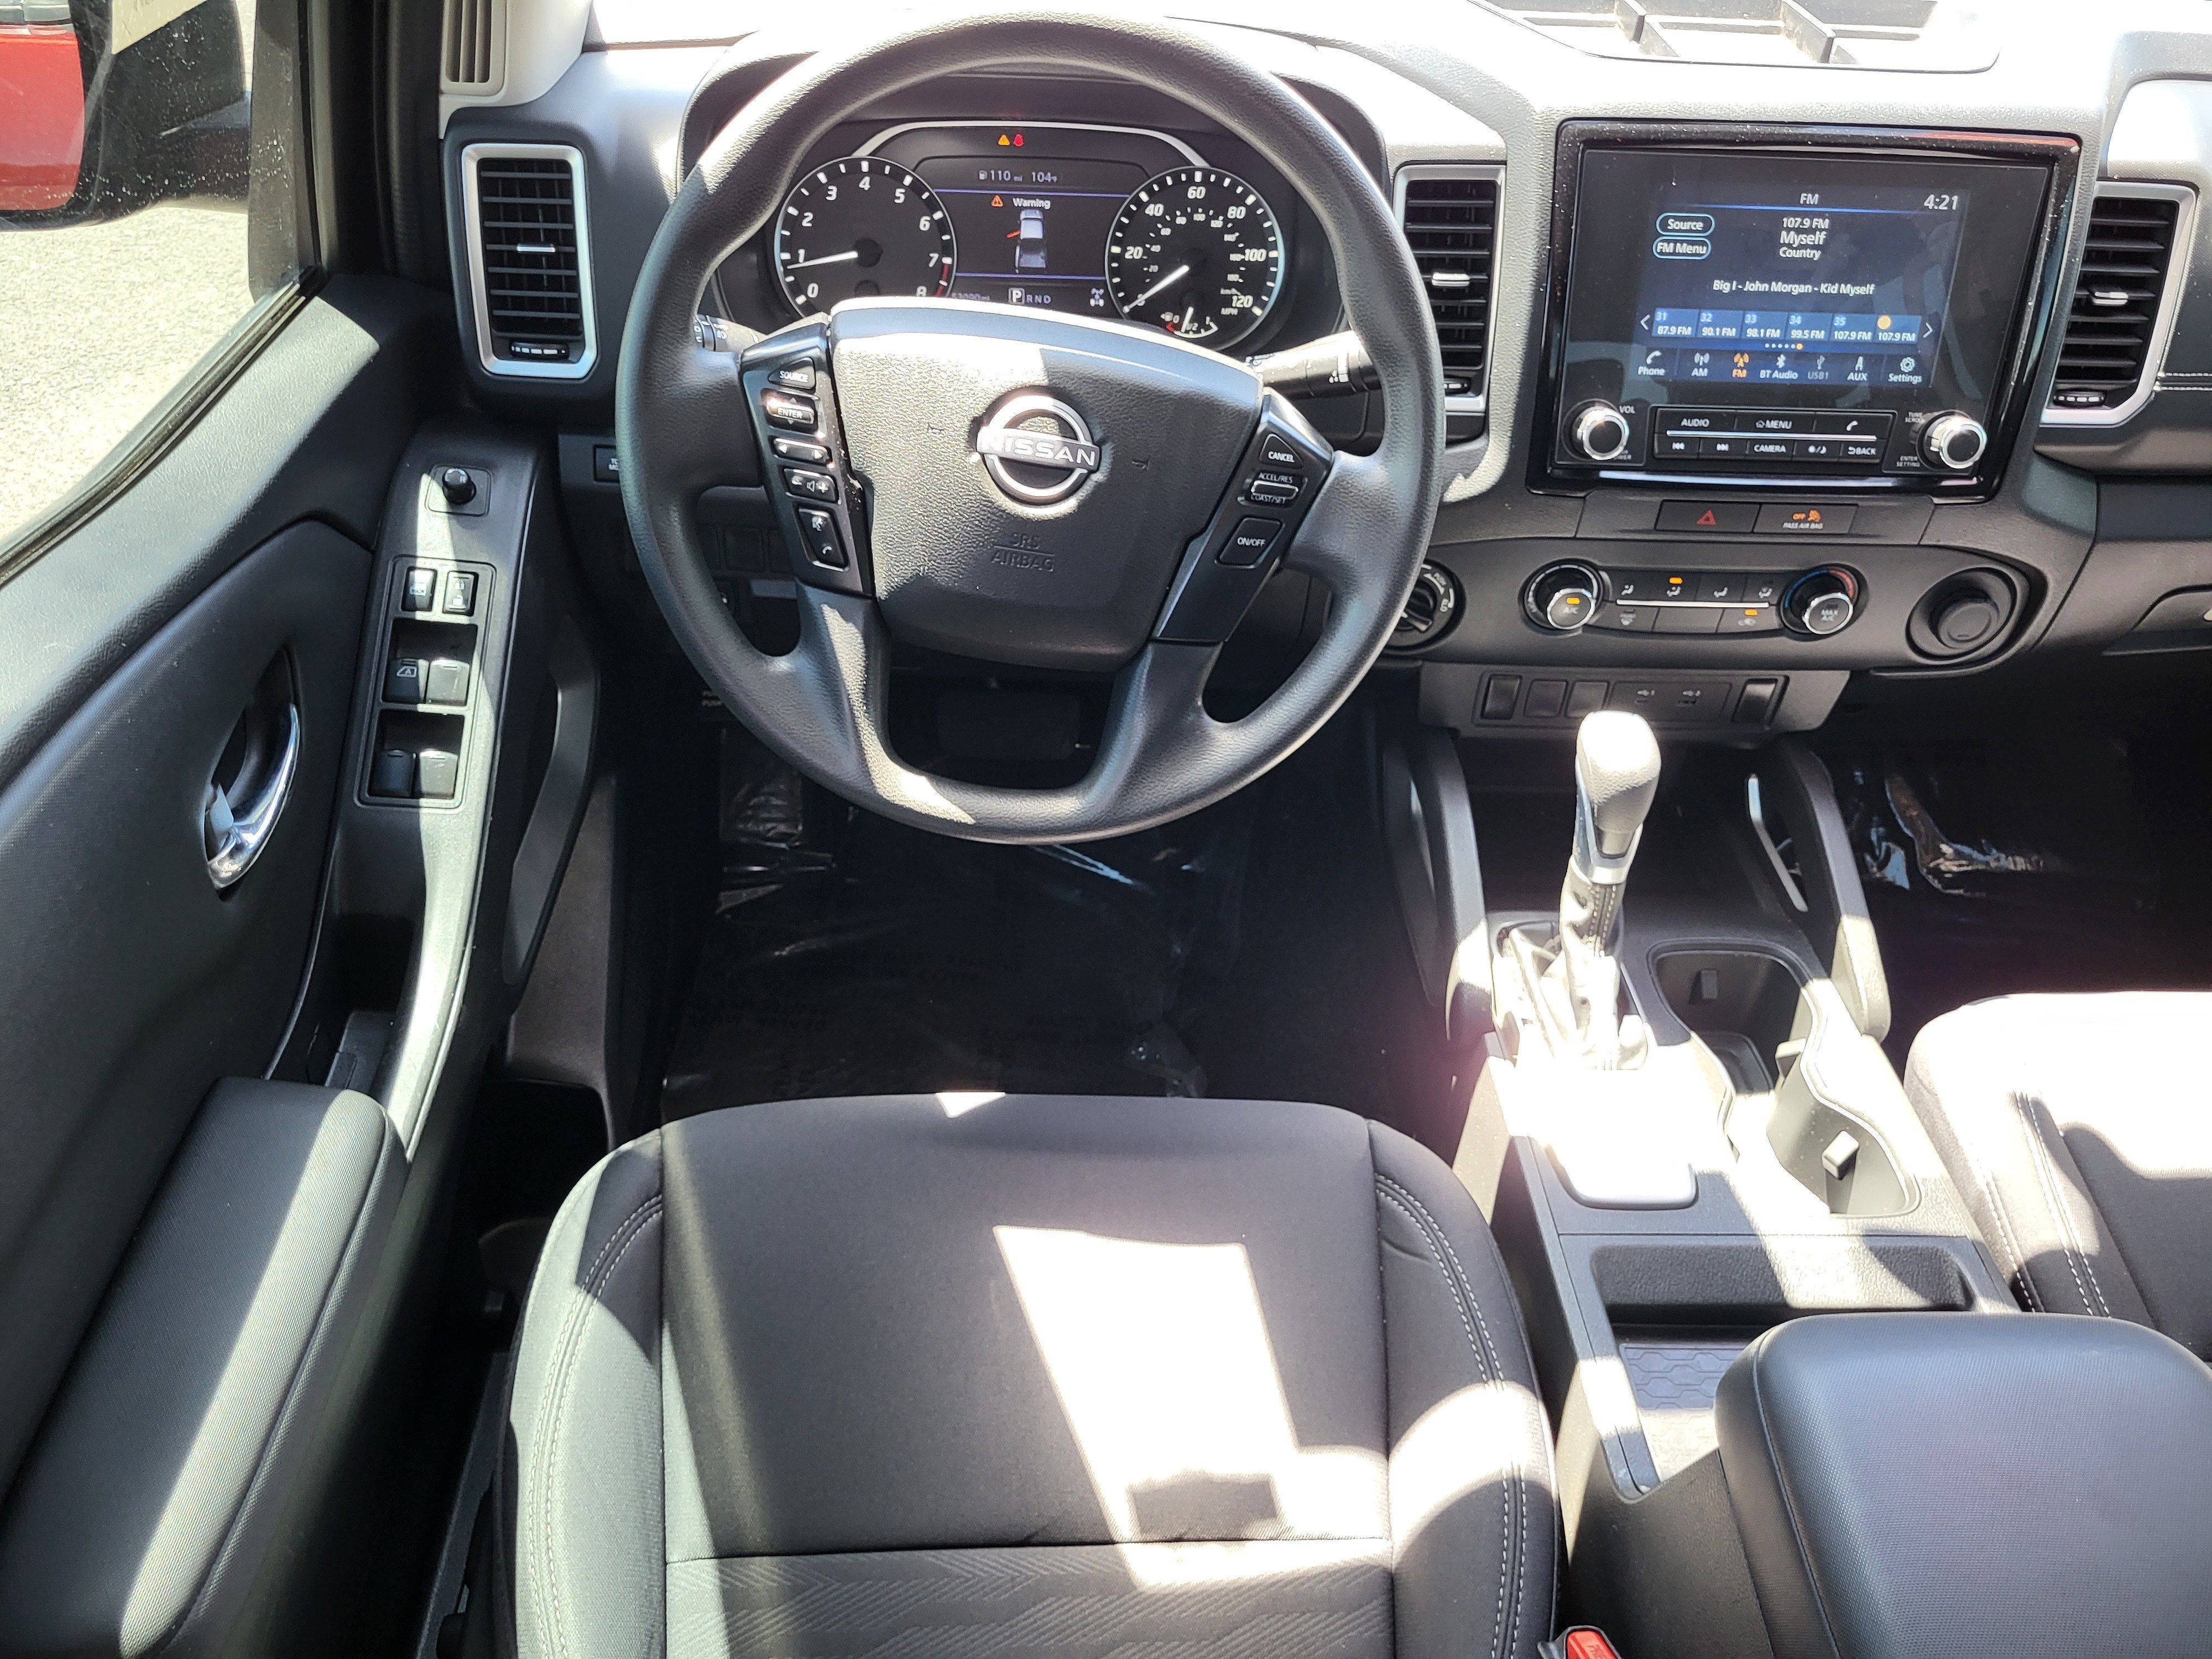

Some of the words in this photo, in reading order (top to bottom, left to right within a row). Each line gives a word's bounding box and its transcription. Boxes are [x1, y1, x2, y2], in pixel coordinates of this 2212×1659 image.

[990, 170, 1011, 181] 110
[859, 176, 871, 191] 4
[826, 185, 837, 201] 3
[894, 188, 906, 204] 5
[1187, 186, 1206, 199] 60
[1013, 197, 1051, 210] Warning
[1800, 194, 1819, 205] FM
[1923, 194, 1958, 211] 4:21
[1145, 204, 1164, 217] 40
[1227, 206, 1246, 220] 80
[802, 212, 813, 227] 2
[919, 216, 931, 231] 6
[1667, 218, 1703, 231] Source
[1782, 217, 1810, 228] 107.9
[1812, 218, 1829, 229] FM
[1780, 231, 1826, 247] Myself
[1124, 246, 1143, 259] 20
[1656, 242, 1673, 253] FM
[1676, 243, 1707, 254] Menu
[1779, 247, 1821, 261] Country
[798, 249, 806, 263] 1
[928, 253, 939, 267] 7
[1244, 248, 1267, 262] 100
[807, 283, 819, 298] 0
[1713, 280, 1730, 293] Big
[1743, 280, 1769, 291] John
[1771, 281, 1812, 295] Morgan
[1820, 282, 1838, 294] Kid
[1840, 283, 1875, 297] Myself
[1013, 290, 1022, 303] P
[1026, 294, 1033, 304] R
[1035, 295, 1042, 304] N
[1232, 295, 1253, 307] 120
[1656, 311, 1667, 321] 31
[1700, 313, 1712, 322] 32
[1745, 314, 1757, 324] 33
[1789, 315, 1802, 325] 34
[1833, 316, 1846, 326] 35
[1657, 326, 1676, 335] 87.9
[1677, 326, 1692, 336] FM
[1721, 327, 1736, 337] FM
[1766, 328, 1781, 338] FM
[1811, 330, 1824, 339] FM
[1834, 331, 1856, 340] 107.9
[1857, 331, 1871, 341] FM
[1878, 332, 1900, 342] 107.9
[1901, 332, 1916, 342] FM
[779, 370, 809, 383] SOURCE
[1637, 366, 1665, 377] Phone
[1691, 368, 1708, 377] AM
[1732, 368, 1747, 378] FM
[1760, 369, 1771, 379] BT
[1772, 370, 1798, 380] Audio
[1846, 372, 1868, 382] AUX
[1887, 372, 1922, 385] Settings
[778, 407, 803, 419] ENTER
[1619, 405, 1635, 414] VOL
[1681, 418, 1710, 427] AUDIO
[1765, 419, 1792, 430] MENU
[1754, 444, 1786, 453] CAMERA
[1856, 446, 1876, 456] BACK
[1268, 451, 1295, 463] CANCEL
[1237, 536, 1265, 547] ON/OFF
[990, 551, 1054, 572] AIRBAG
